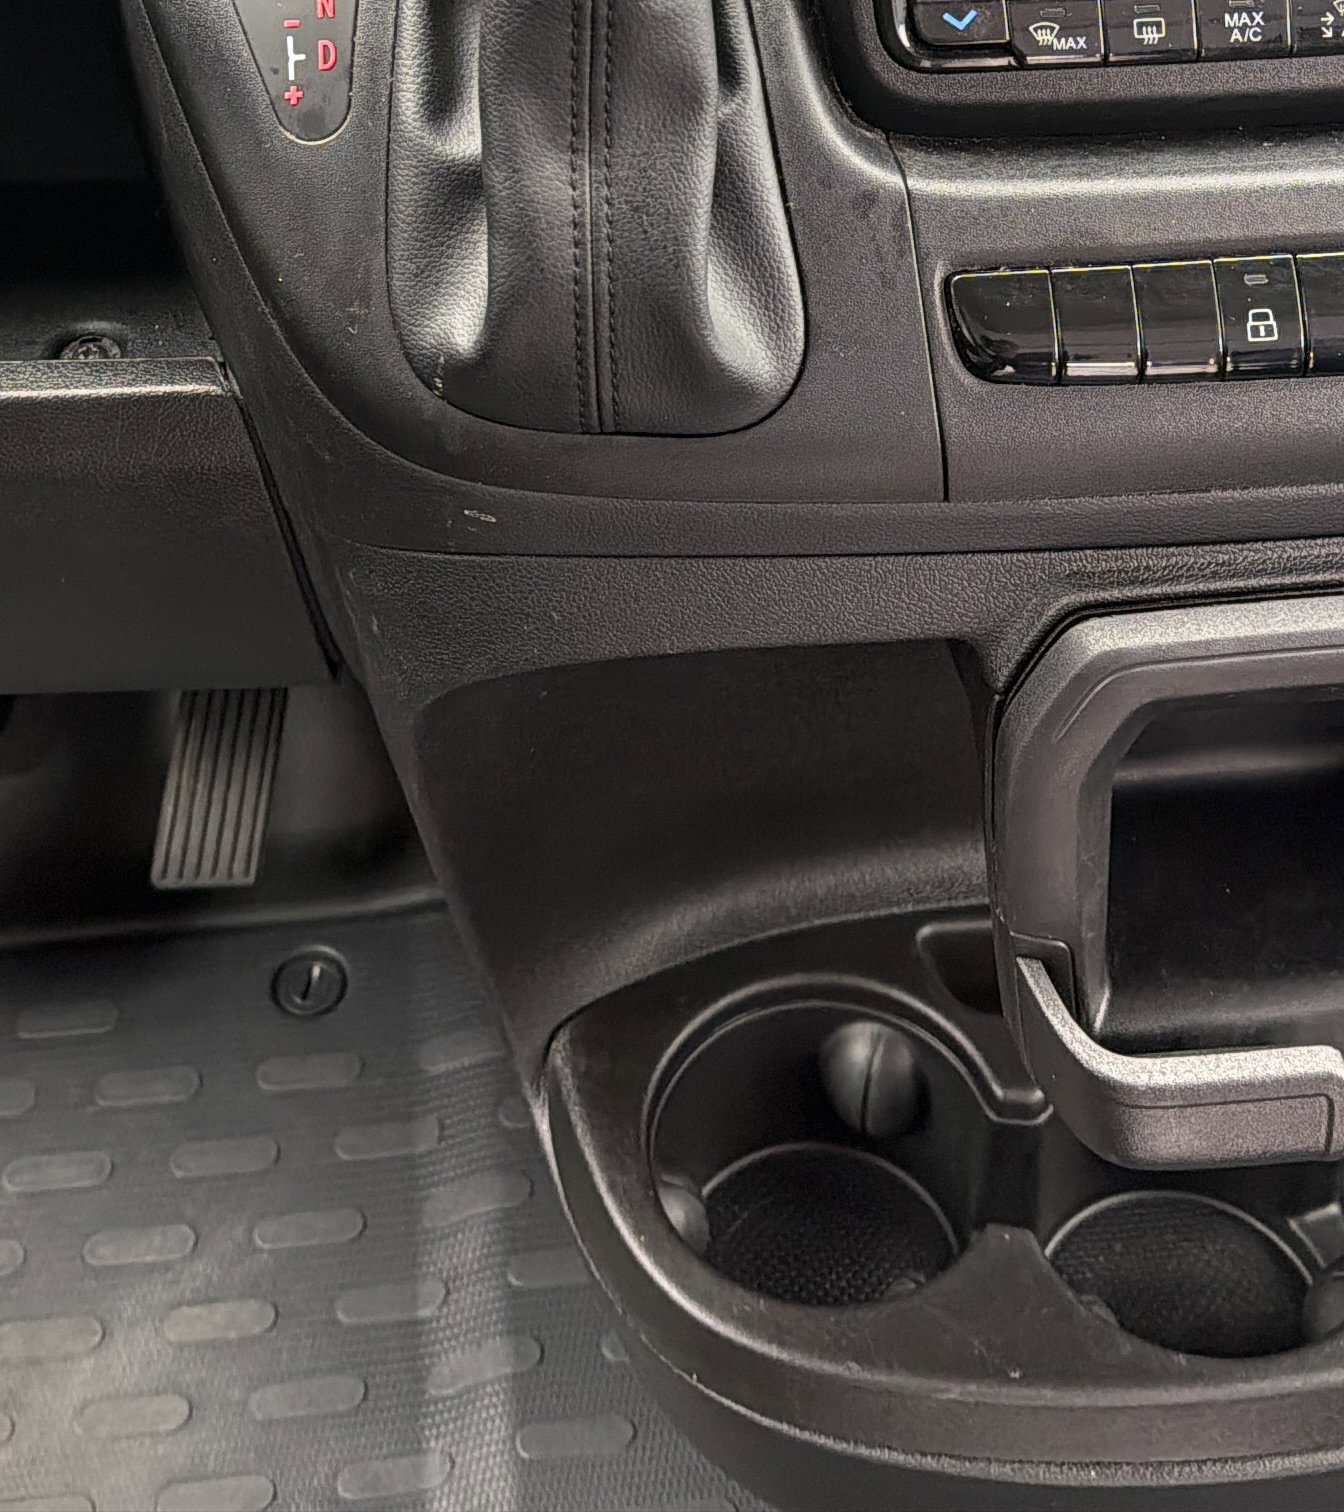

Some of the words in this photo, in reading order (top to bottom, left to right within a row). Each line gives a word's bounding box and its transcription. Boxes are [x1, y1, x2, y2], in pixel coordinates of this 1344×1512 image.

[1224, 12, 1265, 28] MAX
[1229, 25, 1263, 42] A/C
[1052, 35, 1088, 51] MAX
[318, 40, 337, 71] D
